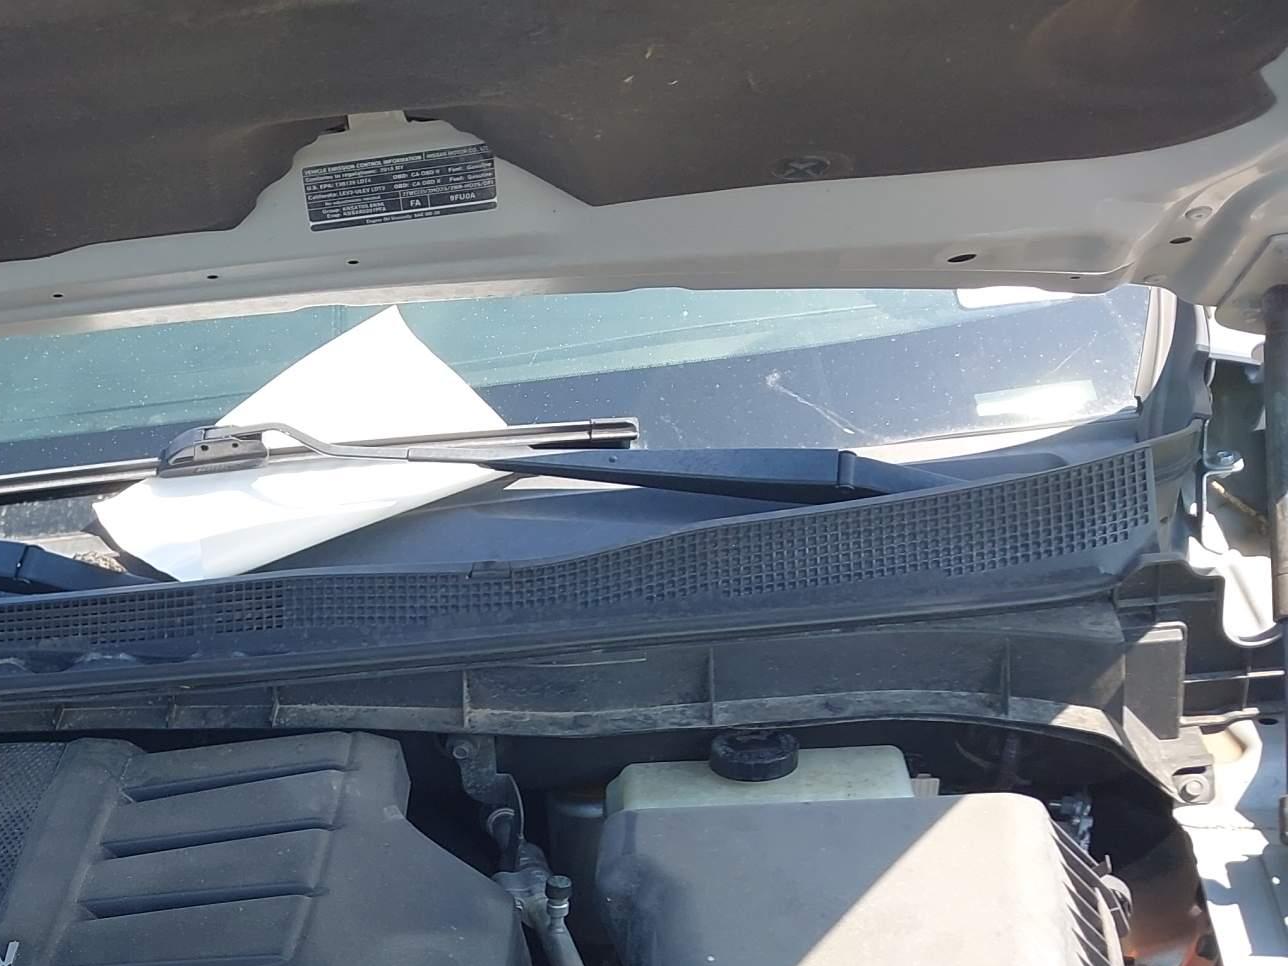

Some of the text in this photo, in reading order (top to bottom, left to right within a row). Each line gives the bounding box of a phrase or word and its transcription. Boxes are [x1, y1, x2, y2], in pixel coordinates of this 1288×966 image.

[304, 156, 422, 176] VEHICLE EMISSION CONTROL INFORMATION
[410, 199, 421, 208] FA
